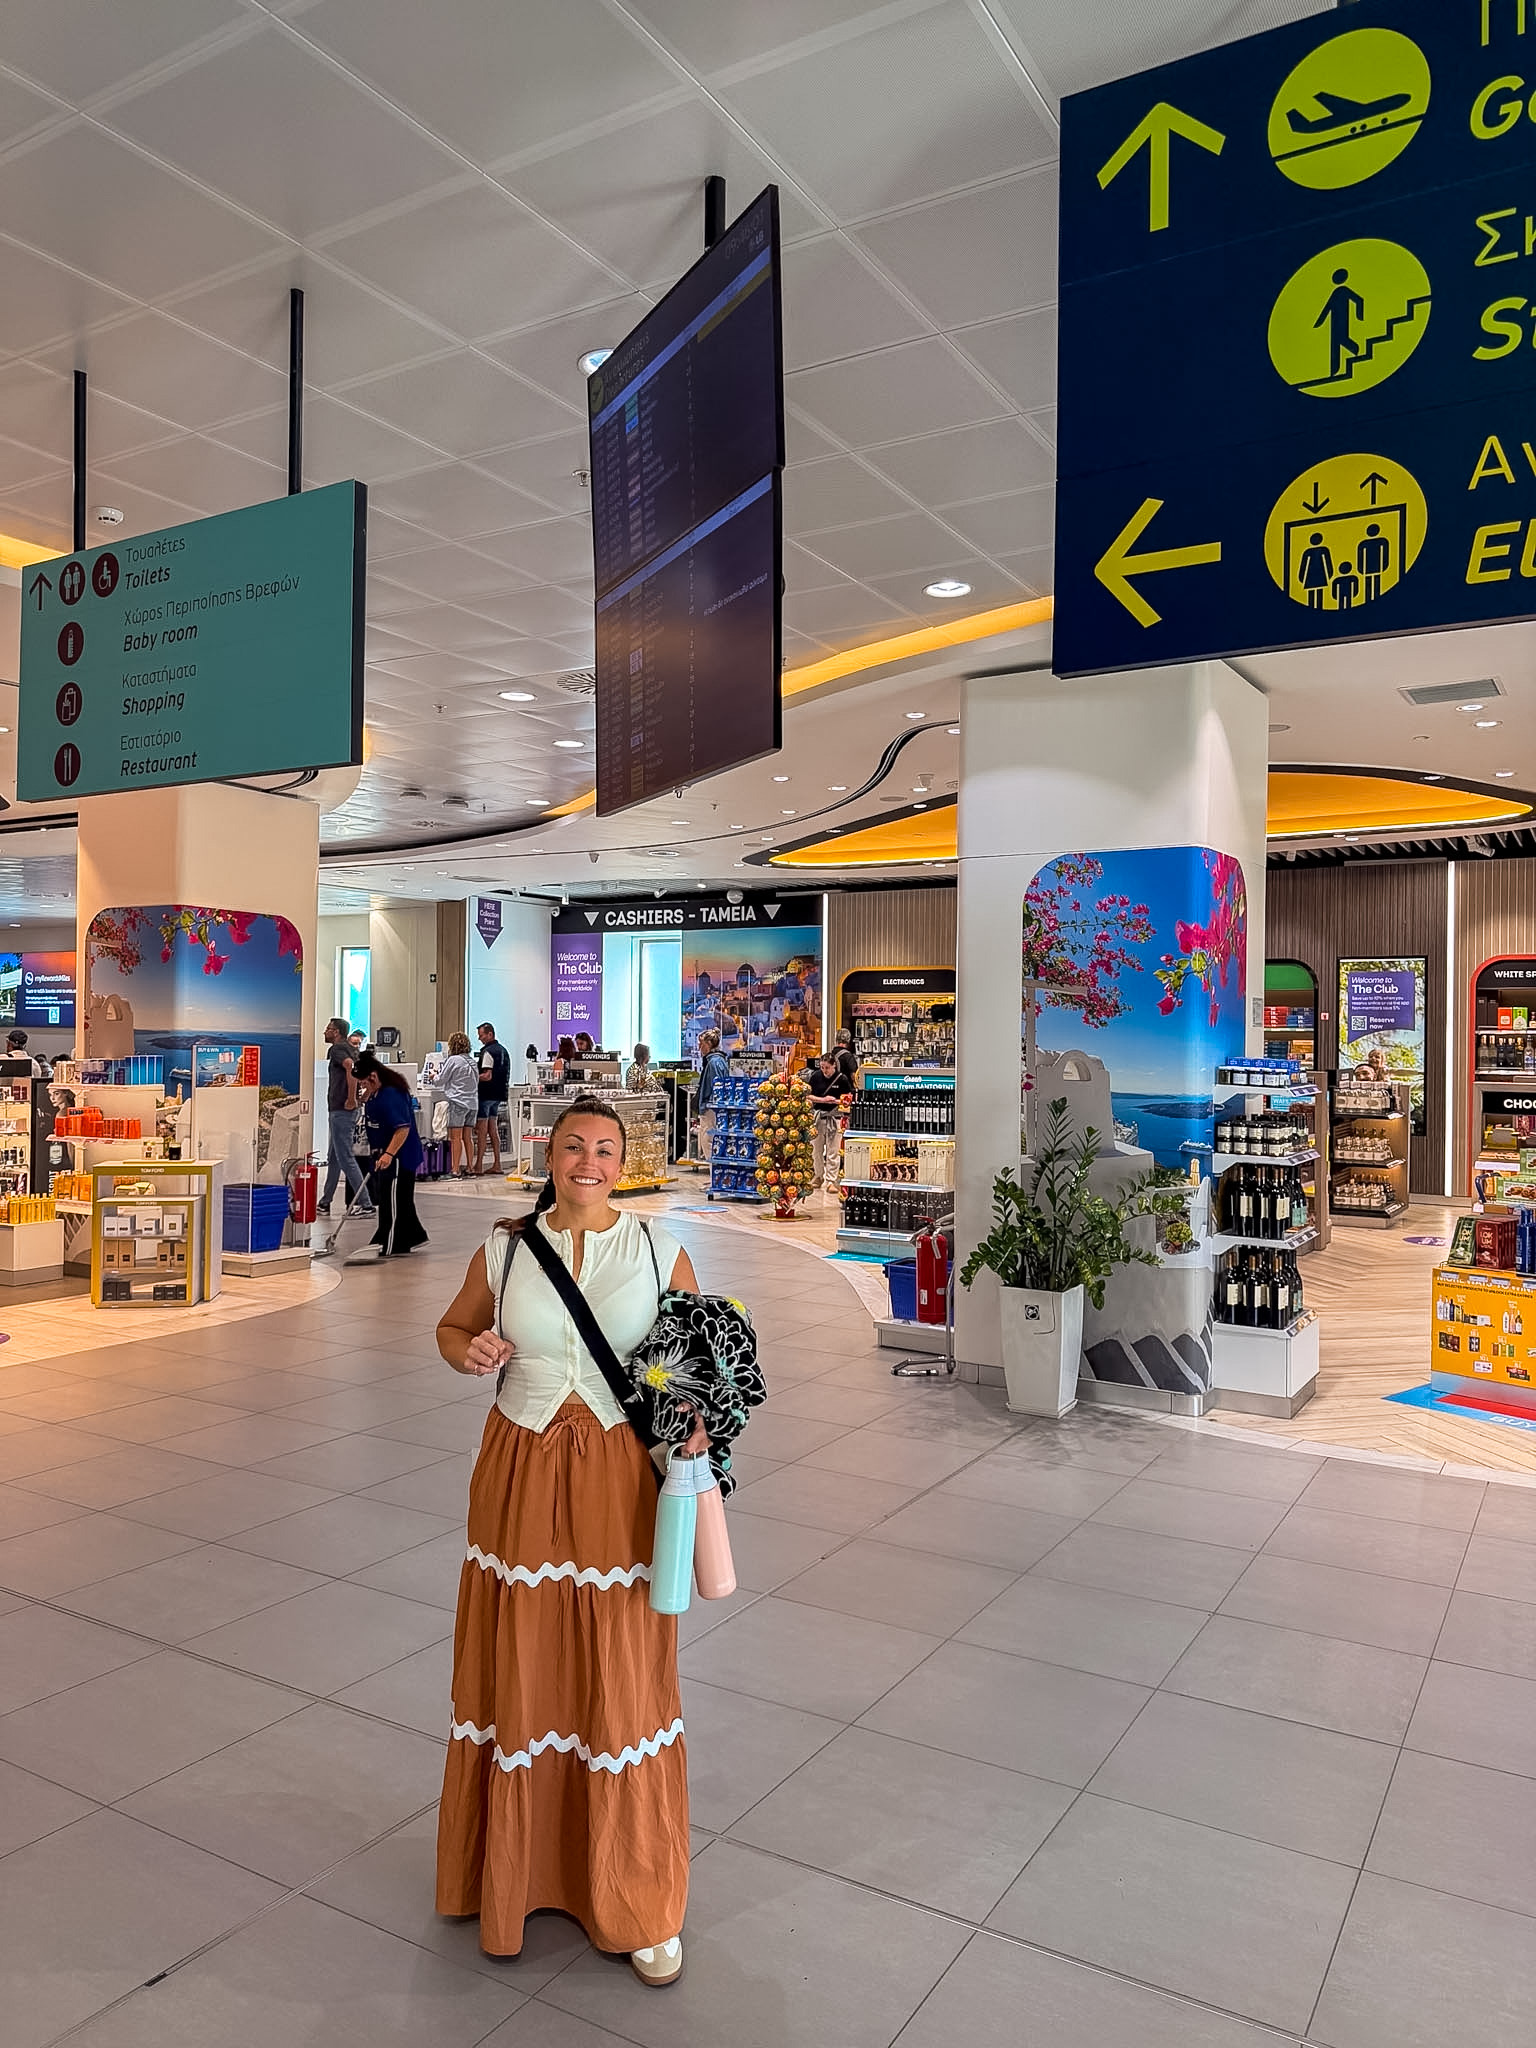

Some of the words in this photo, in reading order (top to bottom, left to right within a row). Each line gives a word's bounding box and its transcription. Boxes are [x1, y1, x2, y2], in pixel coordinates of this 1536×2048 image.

[1469, 75, 1536, 140] G
[126, 538, 186, 563] Τουαλέτες
[125, 567, 171, 590] Toilets
[123, 607, 163, 626] Χώρος
[166, 589, 242, 617] Περιποίησης
[245, 573, 300, 602] Βρεφών
[123, 632, 158, 652] Baby
[162, 625, 198, 645] room
[122, 664, 197, 688] Καταστήματα
[122, 691, 185, 715] Shopping
[120, 729, 182, 750] Εστιατόριο
[120, 751, 197, 776] Restaurant
[605, 909, 684, 926] CASHIERS
[557, 953, 588, 961] Welcome
[557, 963, 577, 974] The
[578, 962, 602, 974] Club
[1352, 985, 1372, 993] The
[1373, 984, 1399, 993] Club
[573, 1012, 590, 1020] today
[899, 1082, 914, 1090] from
